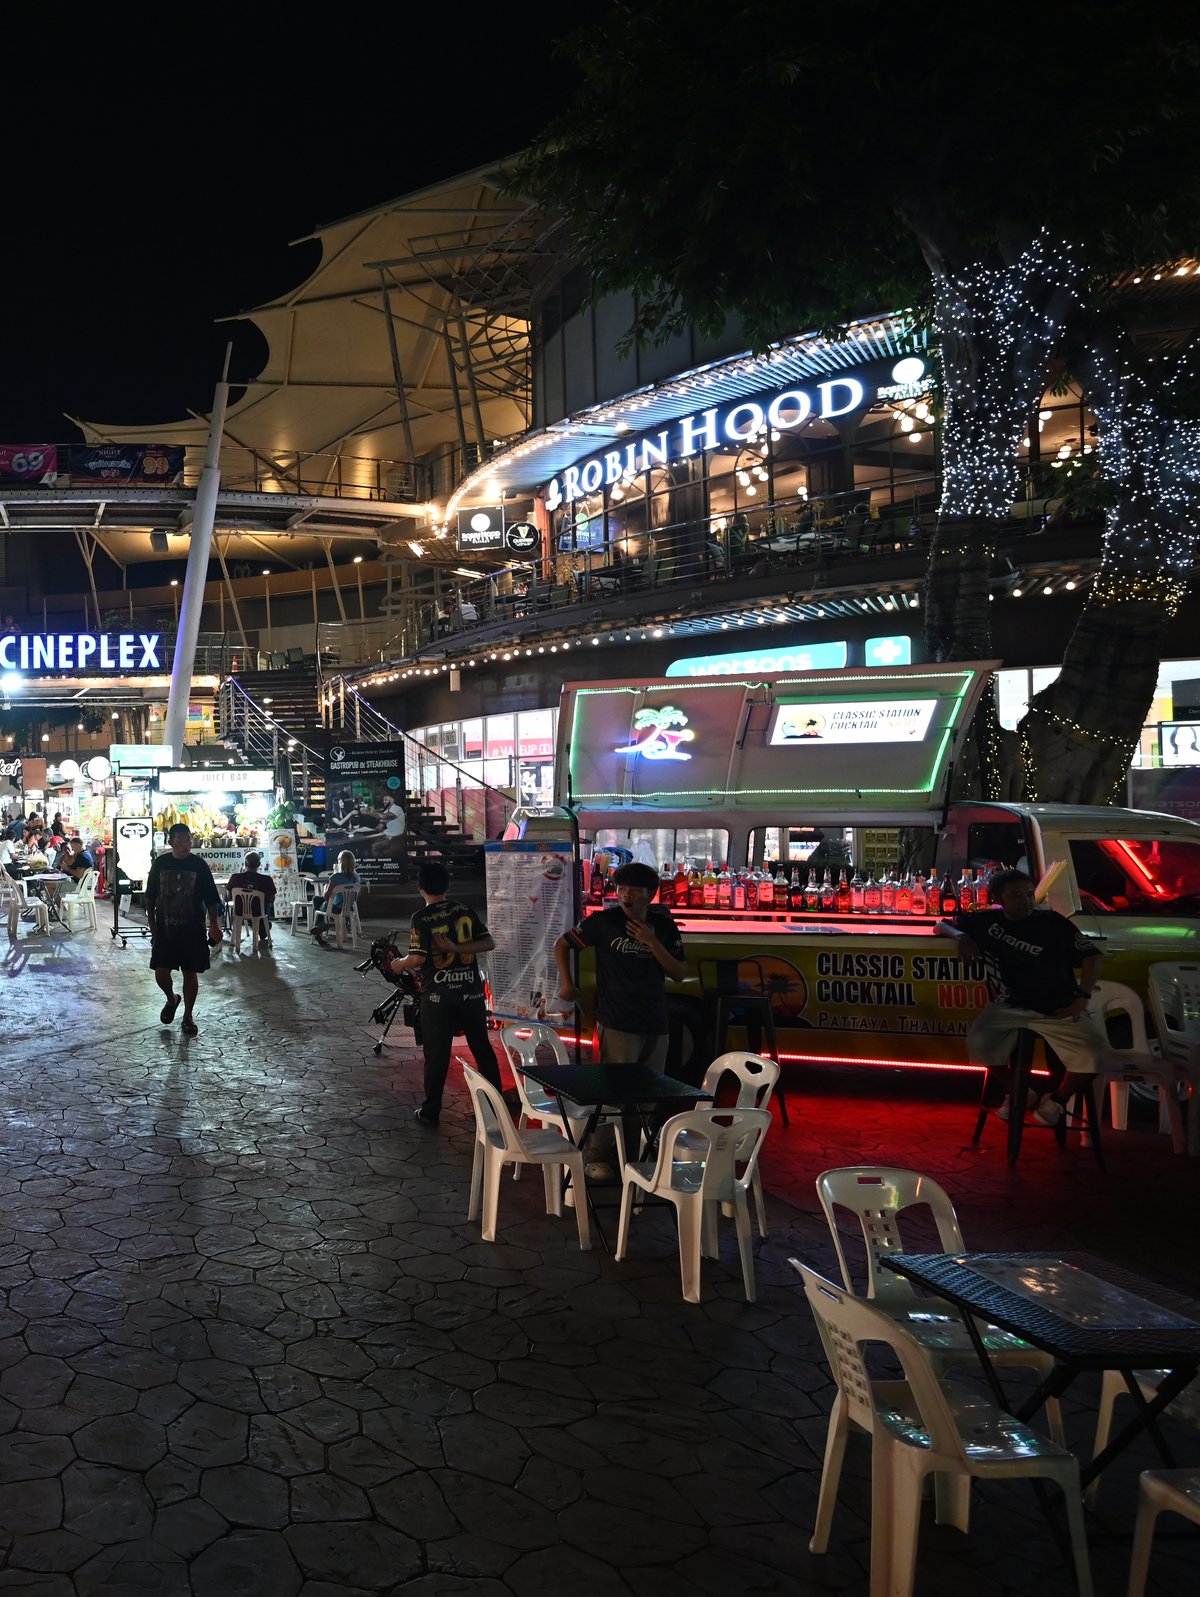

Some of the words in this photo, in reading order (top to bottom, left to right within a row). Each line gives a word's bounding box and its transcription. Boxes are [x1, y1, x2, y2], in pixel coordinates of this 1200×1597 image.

[564, 430, 668, 503] ROBIN
[678, 377, 864, 457] HOOD
[11, 451, 45, 473] 69
[142, 456, 170, 475] 99
[832, 709, 876, 720] CLASSIC
[878, 708, 922, 718] STATION
[830, 720, 878, 730] COCKTAIL
[330, 761, 359, 770] GASTROPUB
[366, 759, 399, 769] STEAKHOUSE
[202, 773, 226, 782] JUICE
[230, 773, 249, 782] BAR
[196, 851, 242, 860] SMOOTHIES
[817, 952, 905, 979] CLASSIC
[912, 956, 988, 982] STATIO
[433, 969, 475, 984] Chang
[817, 979, 916, 1007] COCKTAIL
[938, 983, 990, 1009] NO.0
[818, 1012, 889, 1030] PATTAYA
[898, 1015, 974, 1034] THAILAN
